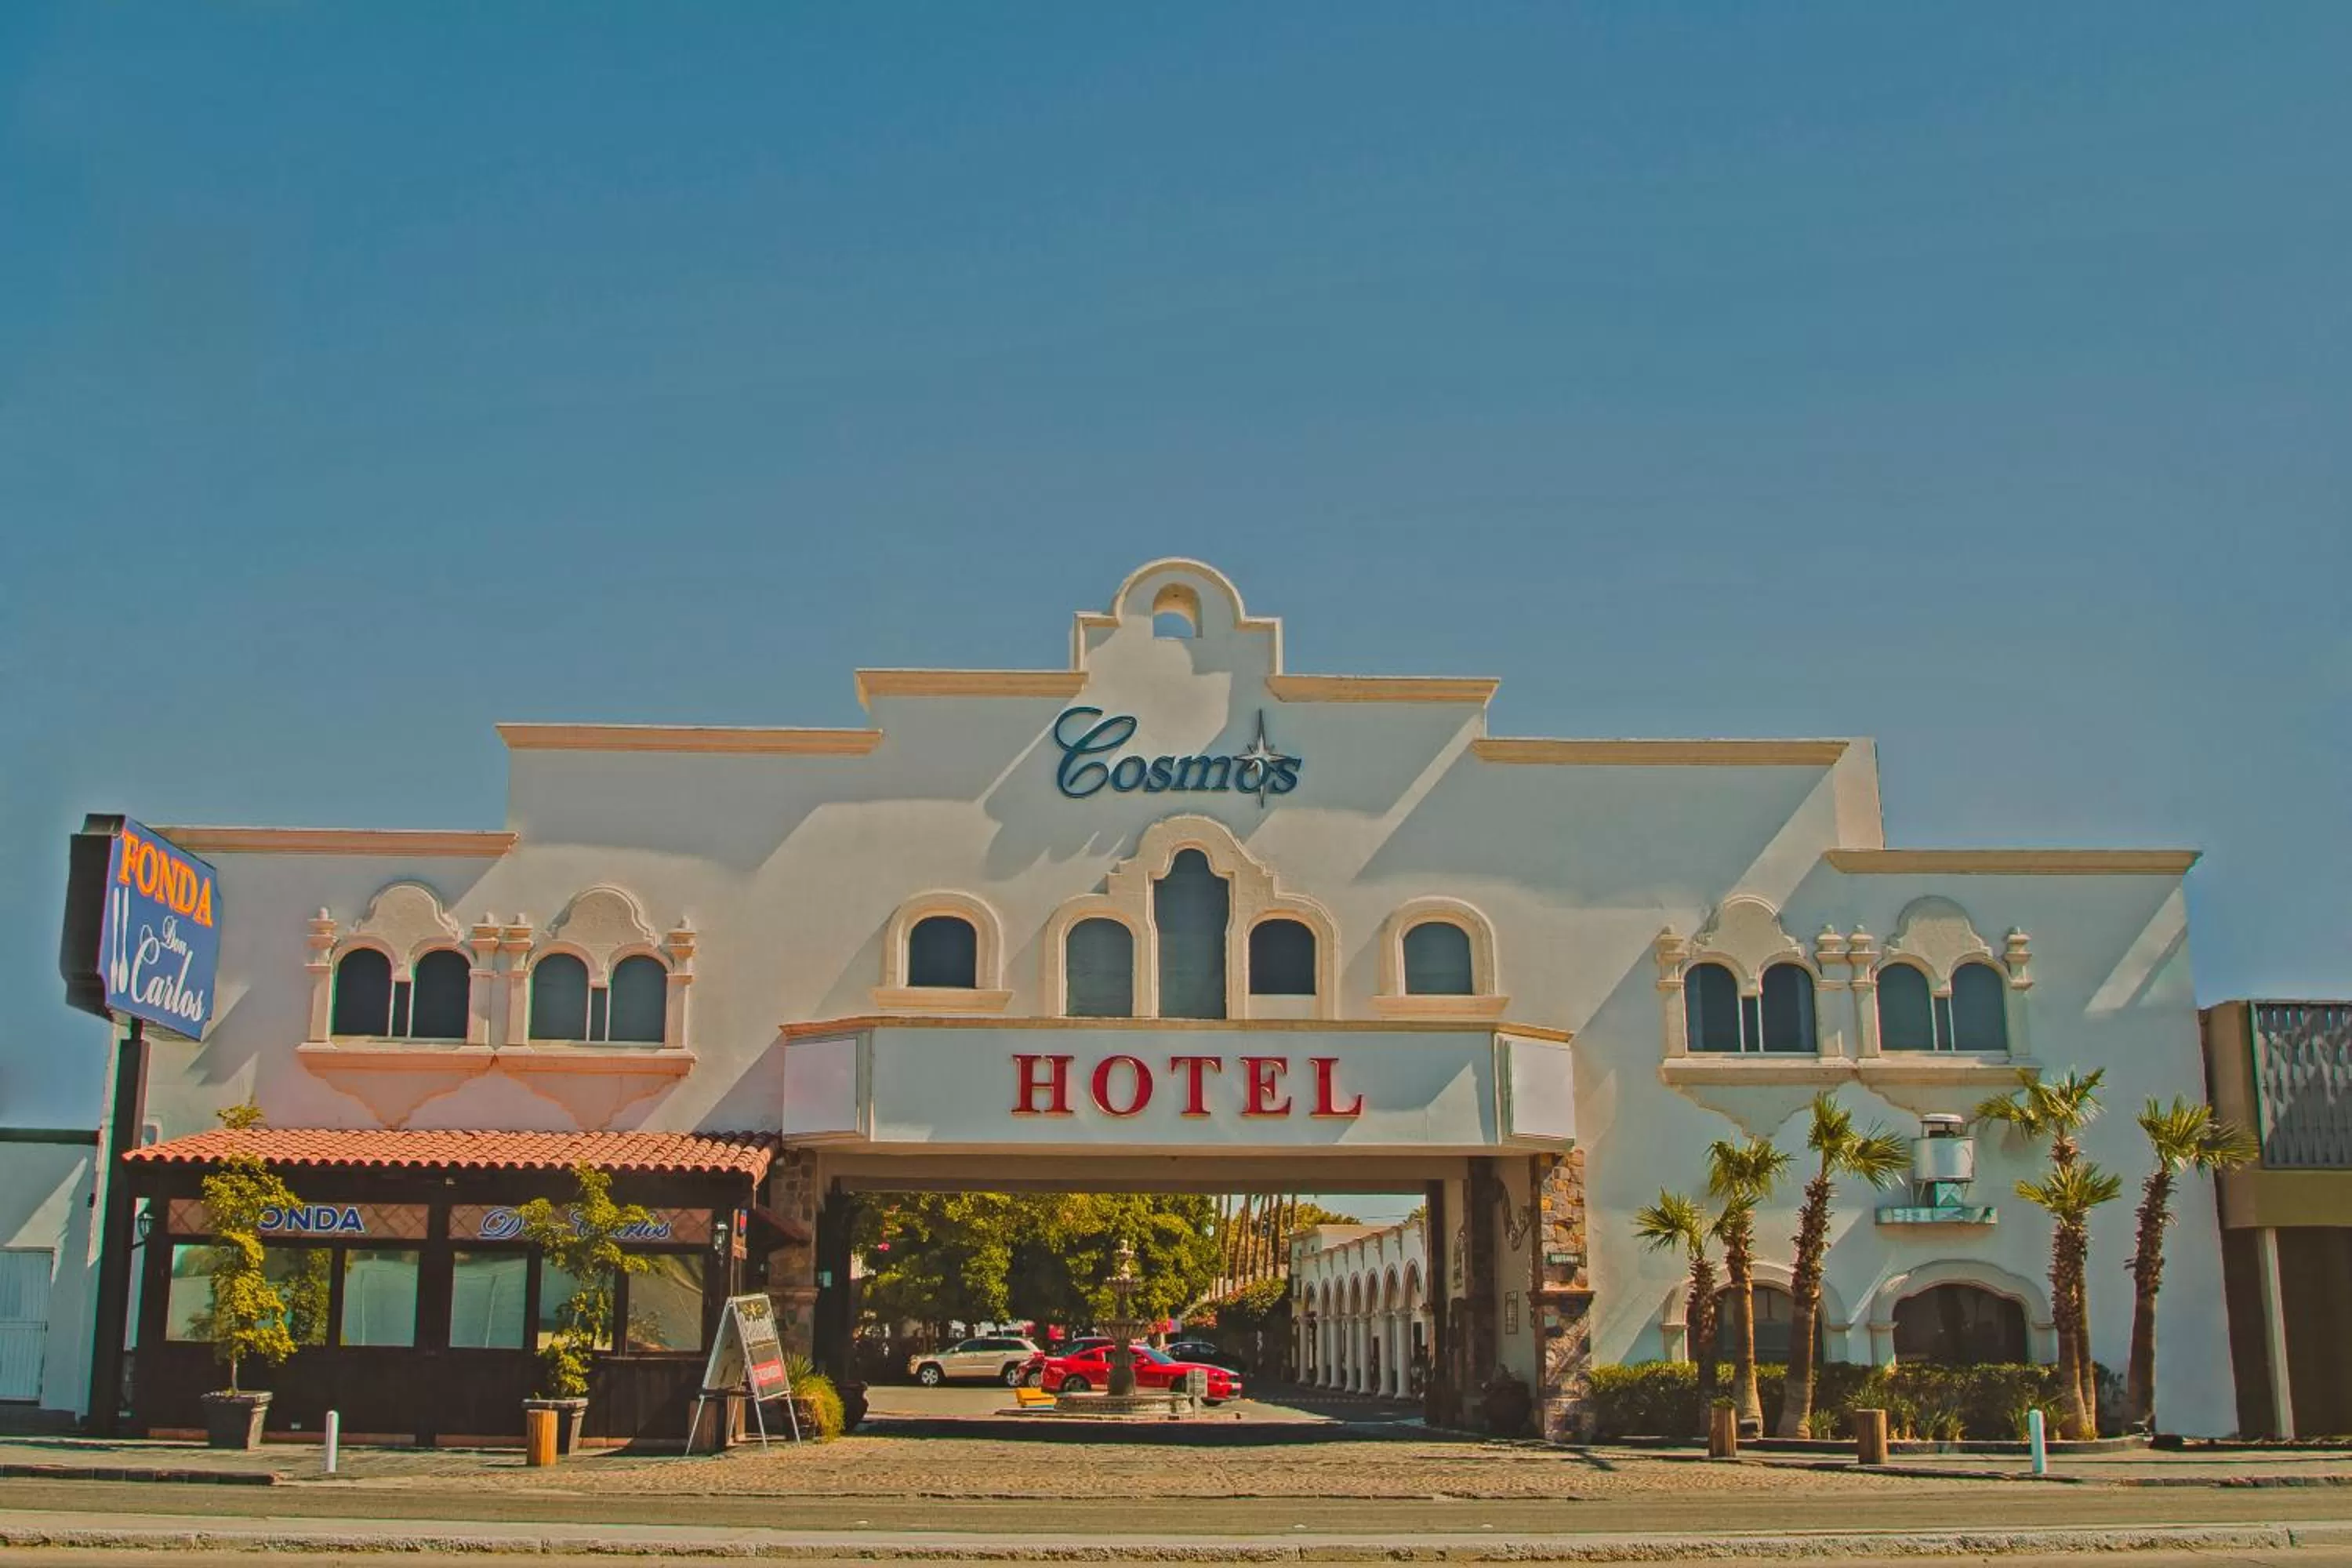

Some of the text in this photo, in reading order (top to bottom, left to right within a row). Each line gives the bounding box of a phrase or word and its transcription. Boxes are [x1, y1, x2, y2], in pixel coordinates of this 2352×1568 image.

[1055, 706, 1302, 799] Cosmos
[118, 831, 214, 927] FONDA
[131, 924, 205, 1022] Carlos
[1011, 1054, 1363, 1118] HOTEL
[256, 1205, 365, 1233] ONDA
